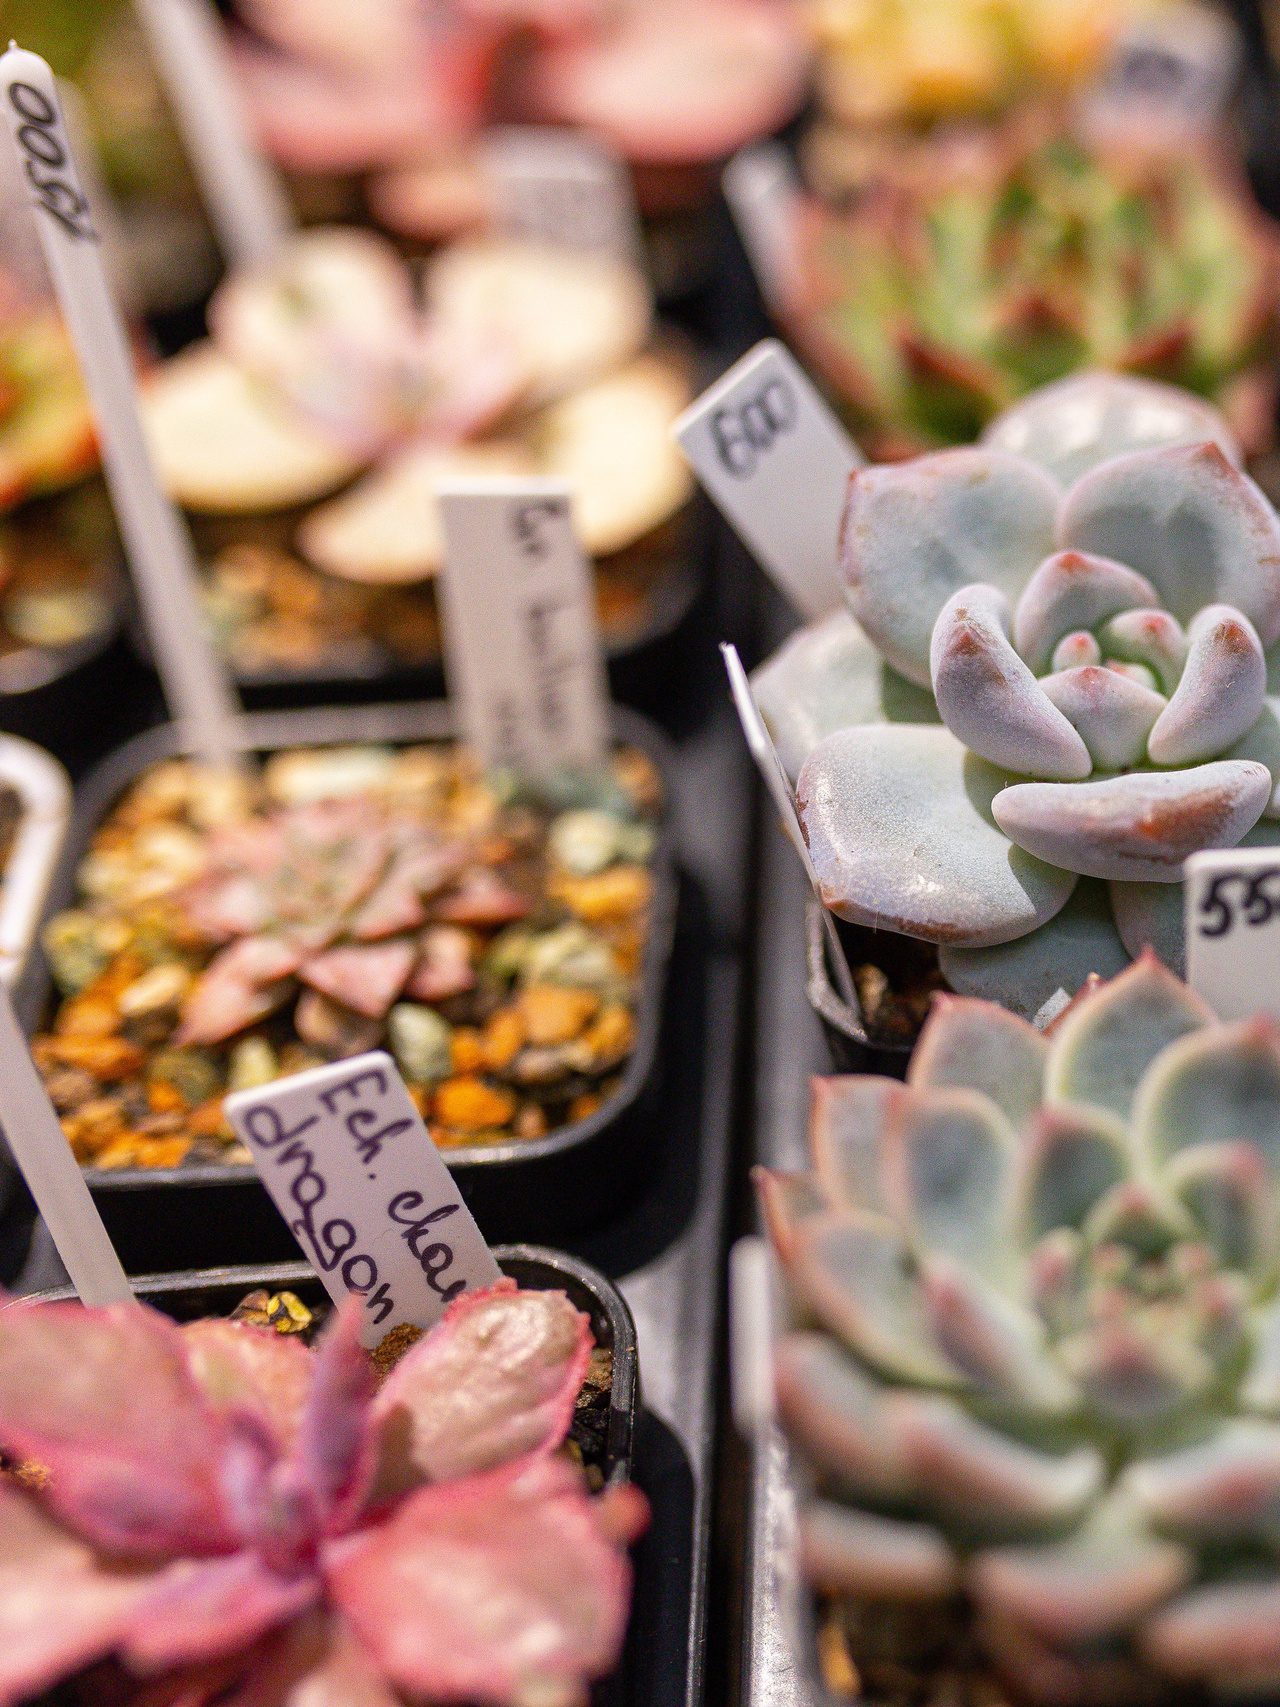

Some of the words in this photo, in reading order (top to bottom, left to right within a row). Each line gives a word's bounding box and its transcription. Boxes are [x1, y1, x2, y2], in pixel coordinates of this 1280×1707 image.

[8, 81, 101, 242] 1500
[707, 376, 797, 480] 600
[319, 1068, 414, 1180] Ech.
[243, 1104, 395, 1325] dragon
